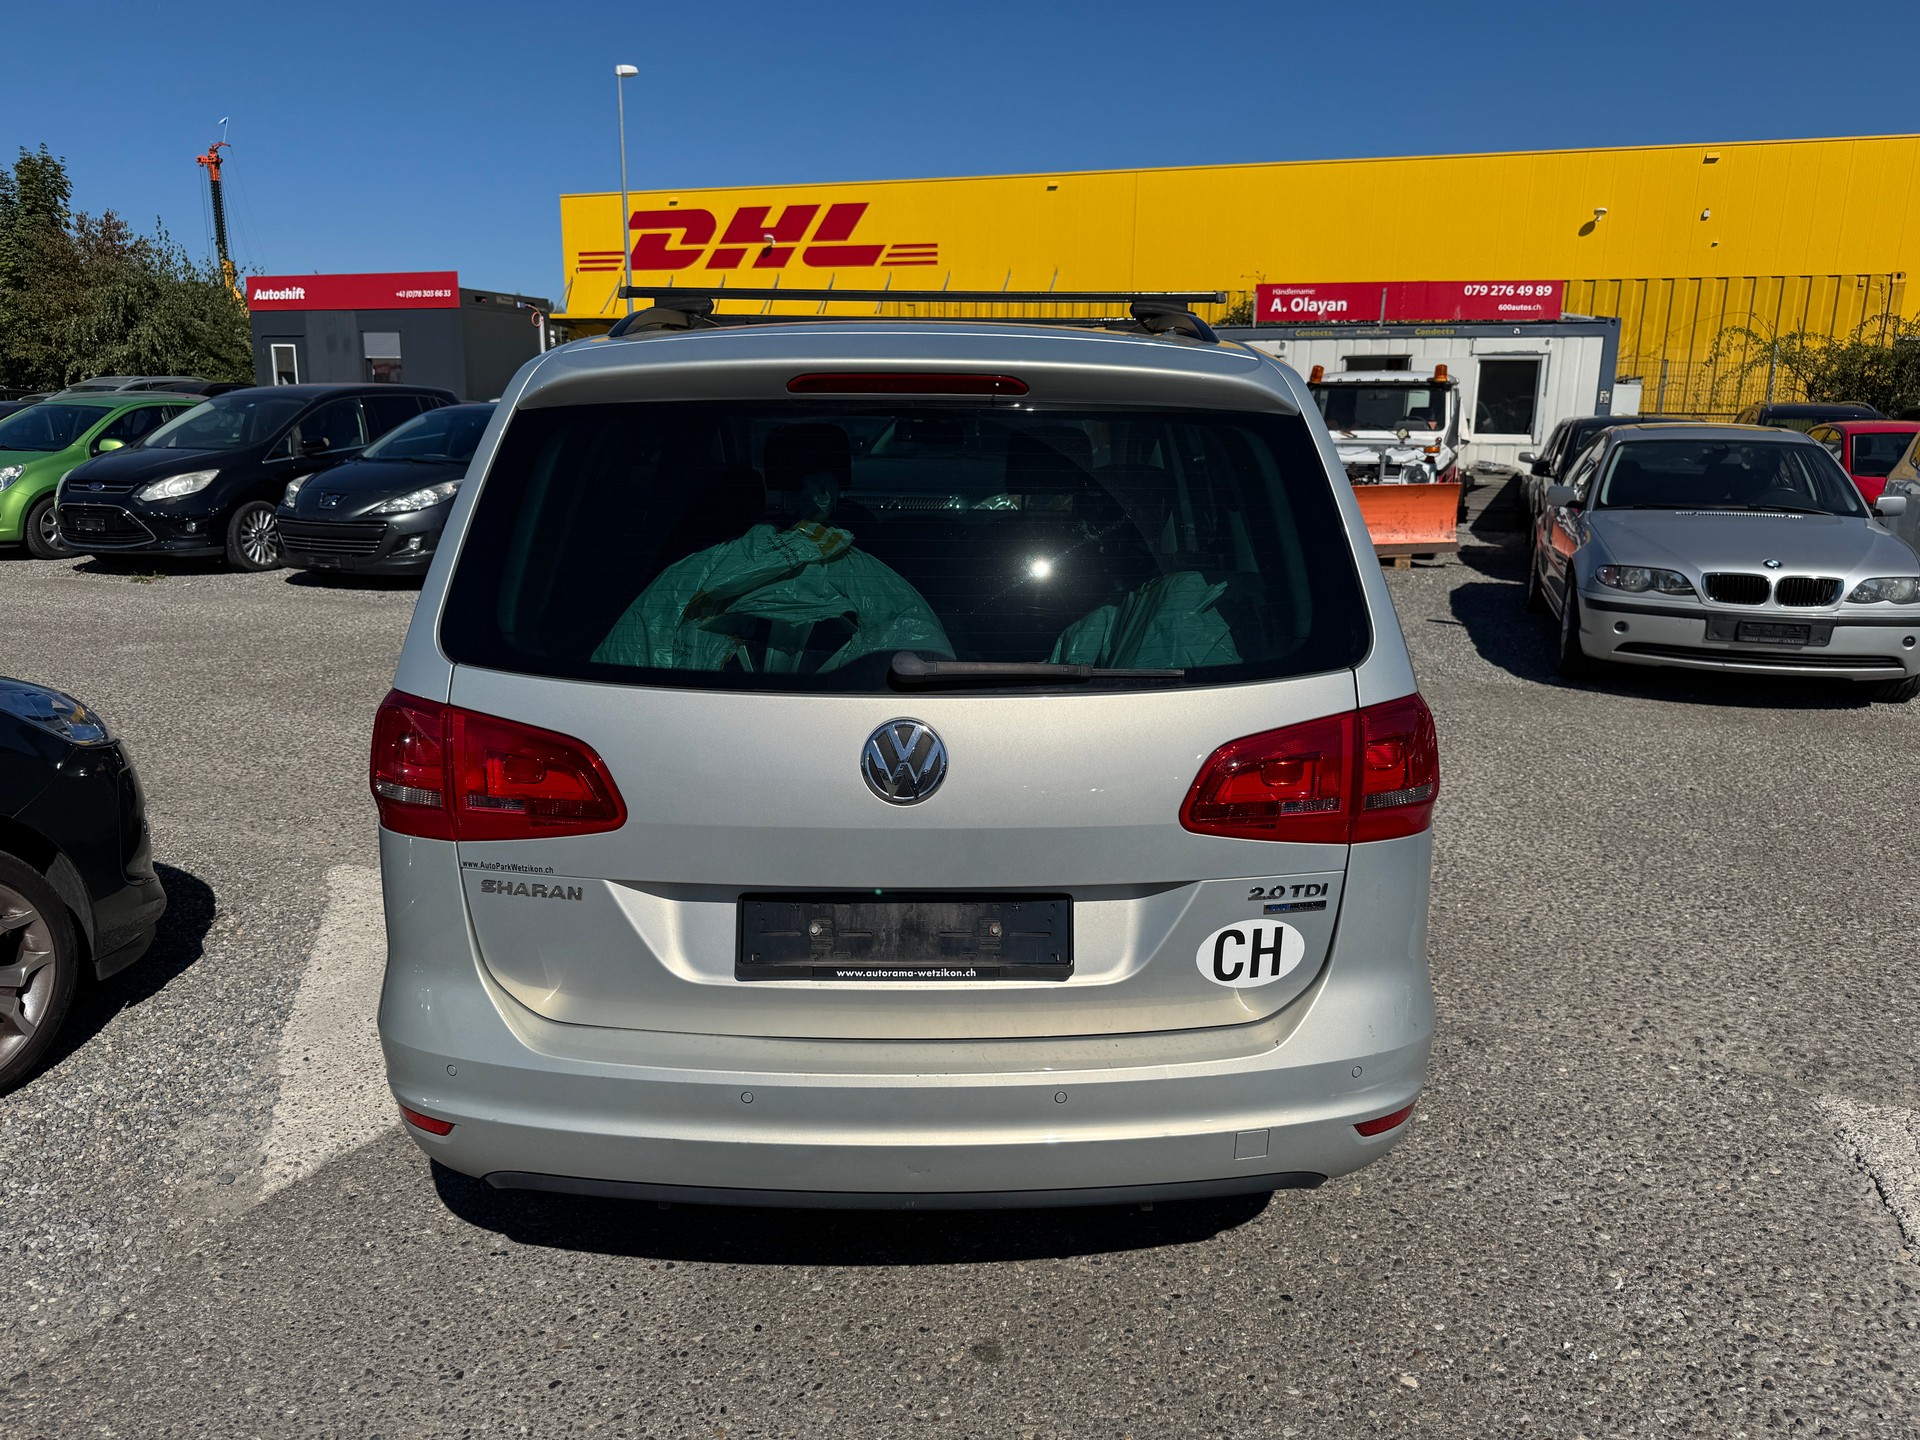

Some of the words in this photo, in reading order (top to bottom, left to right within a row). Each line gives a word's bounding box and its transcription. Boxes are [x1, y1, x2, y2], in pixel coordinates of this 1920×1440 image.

[626, 202, 887, 270] DHL
[254, 286, 306, 300] Autoshift
[1272, 287, 1316, 296] Händlername:
[1463, 284, 1488, 297] 079
[1490, 284, 1515, 297] 276
[1516, 284, 1533, 297] 49
[1535, 284, 1553, 297] 89
[1270, 298, 1287, 312] A.
[1290, 297, 1348, 316] Olayan
[1497, 303, 1542, 312] 600autos.ch
[1414, 328, 1455, 336] Condecta
[462, 860, 554, 874] www.AutoParkWetzikon.ch
[481, 879, 583, 902] SHARAN
[1247, 885, 1286, 901] 2.0
[1289, 882, 1329, 899] TDI
[1213, 926, 1284, 982] CH
[836, 968, 977, 979] www.autorama-wetzikon.ch
